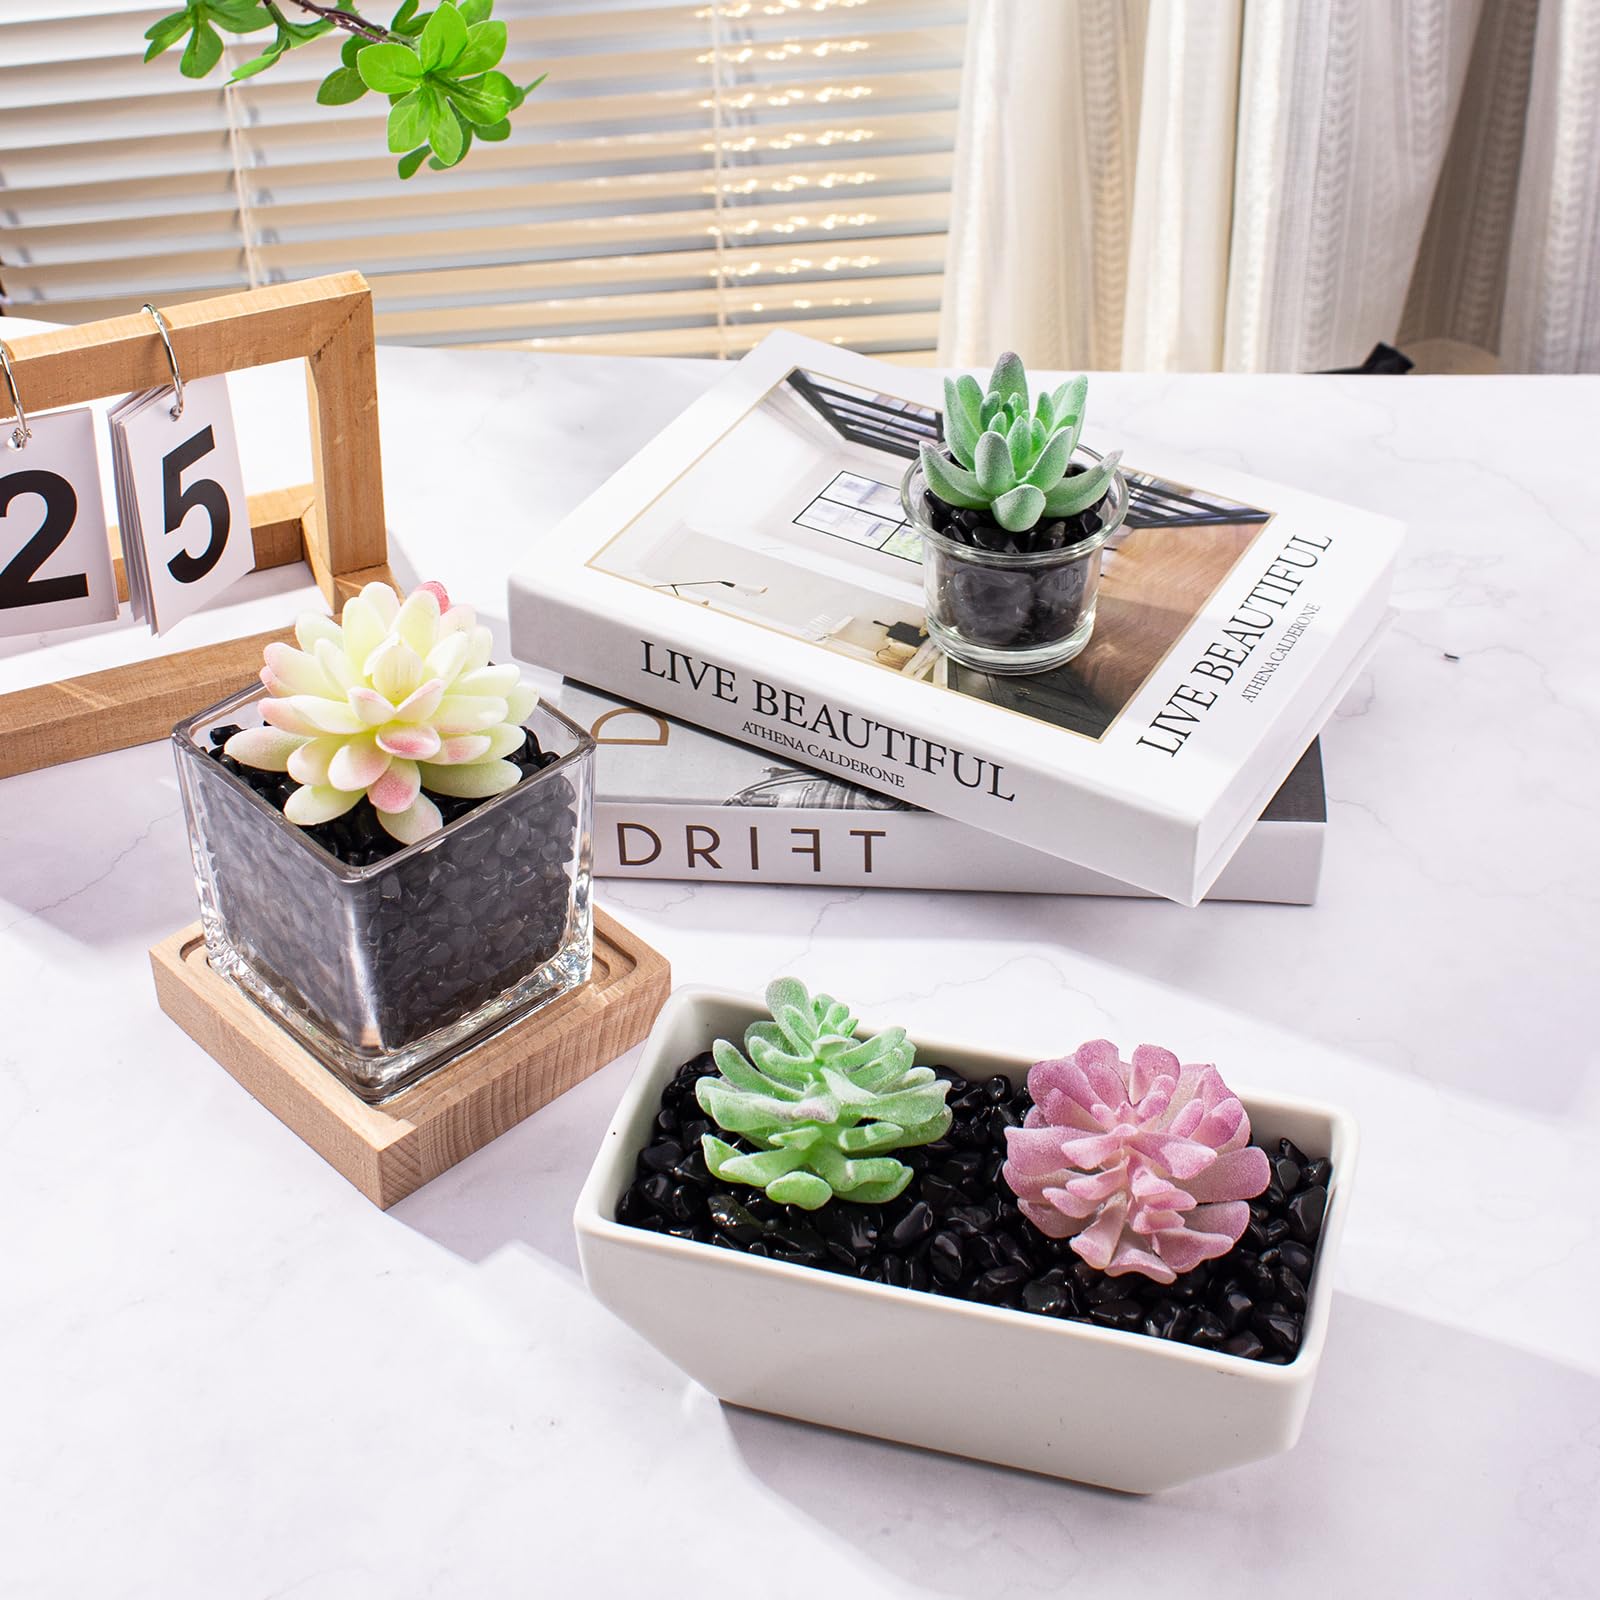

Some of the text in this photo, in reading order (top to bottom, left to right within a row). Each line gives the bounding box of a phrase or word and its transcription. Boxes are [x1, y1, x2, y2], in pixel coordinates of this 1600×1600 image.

[0, 424, 231, 609] 2 5
[1136, 534, 1333, 757] LIVE BEAUTIFUL
[1240, 602, 1321, 703] ATHENA CALDERONE
[640, 640, 1017, 802] LIVE BEAUTIFUL
[742, 721, 905, 788] ATHENA CALDERONE
[616, 822, 887, 873] DRIFT
